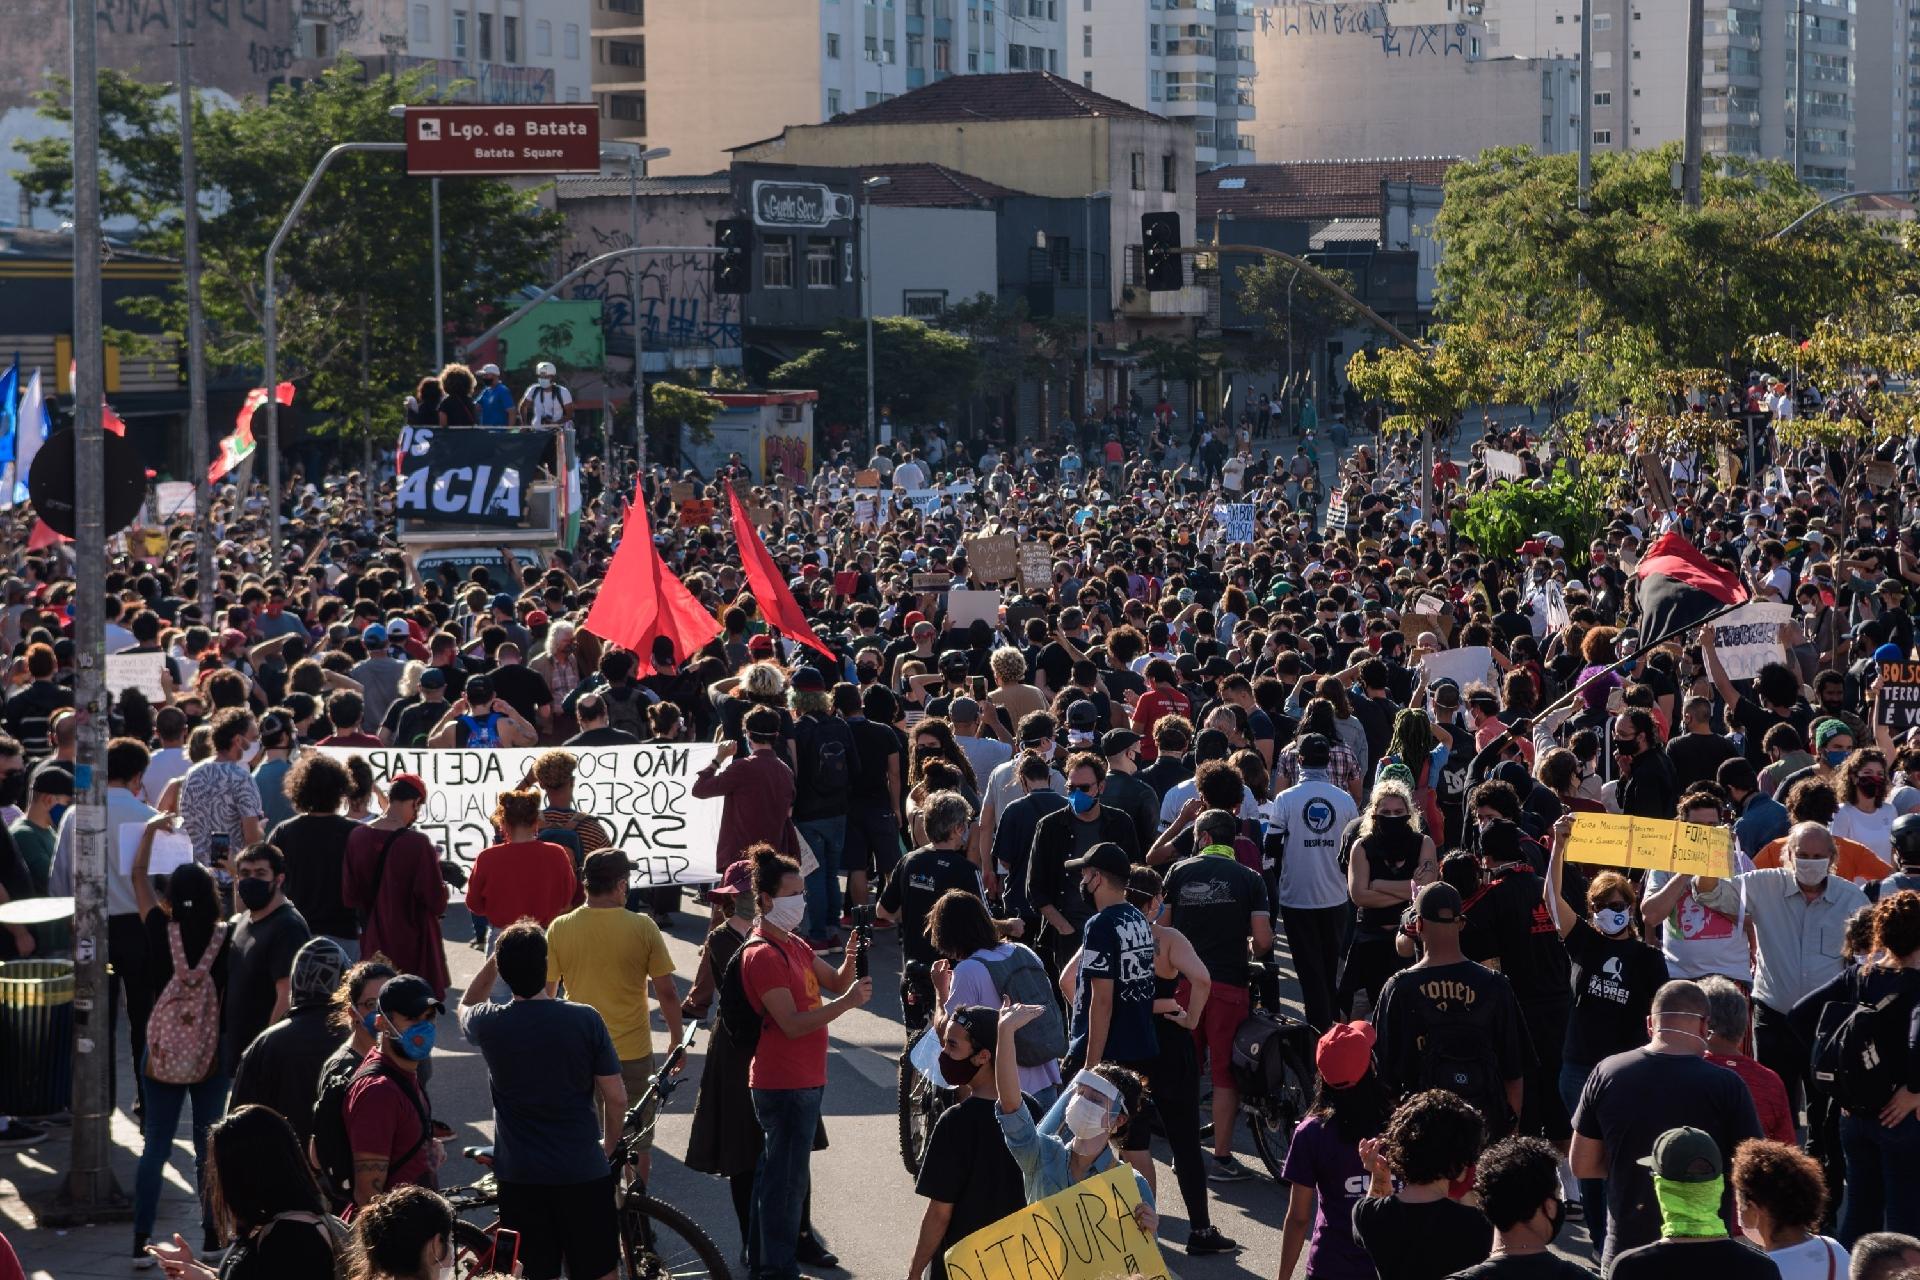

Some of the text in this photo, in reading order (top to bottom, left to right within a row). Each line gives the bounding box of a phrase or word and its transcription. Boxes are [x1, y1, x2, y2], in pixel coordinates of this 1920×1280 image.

[450, 120, 588, 140] Lgo. da Batata
[475, 148, 564, 160] Batata Square
[1885, 703, 1895, 723] É
[1684, 824, 1709, 847] FORA
